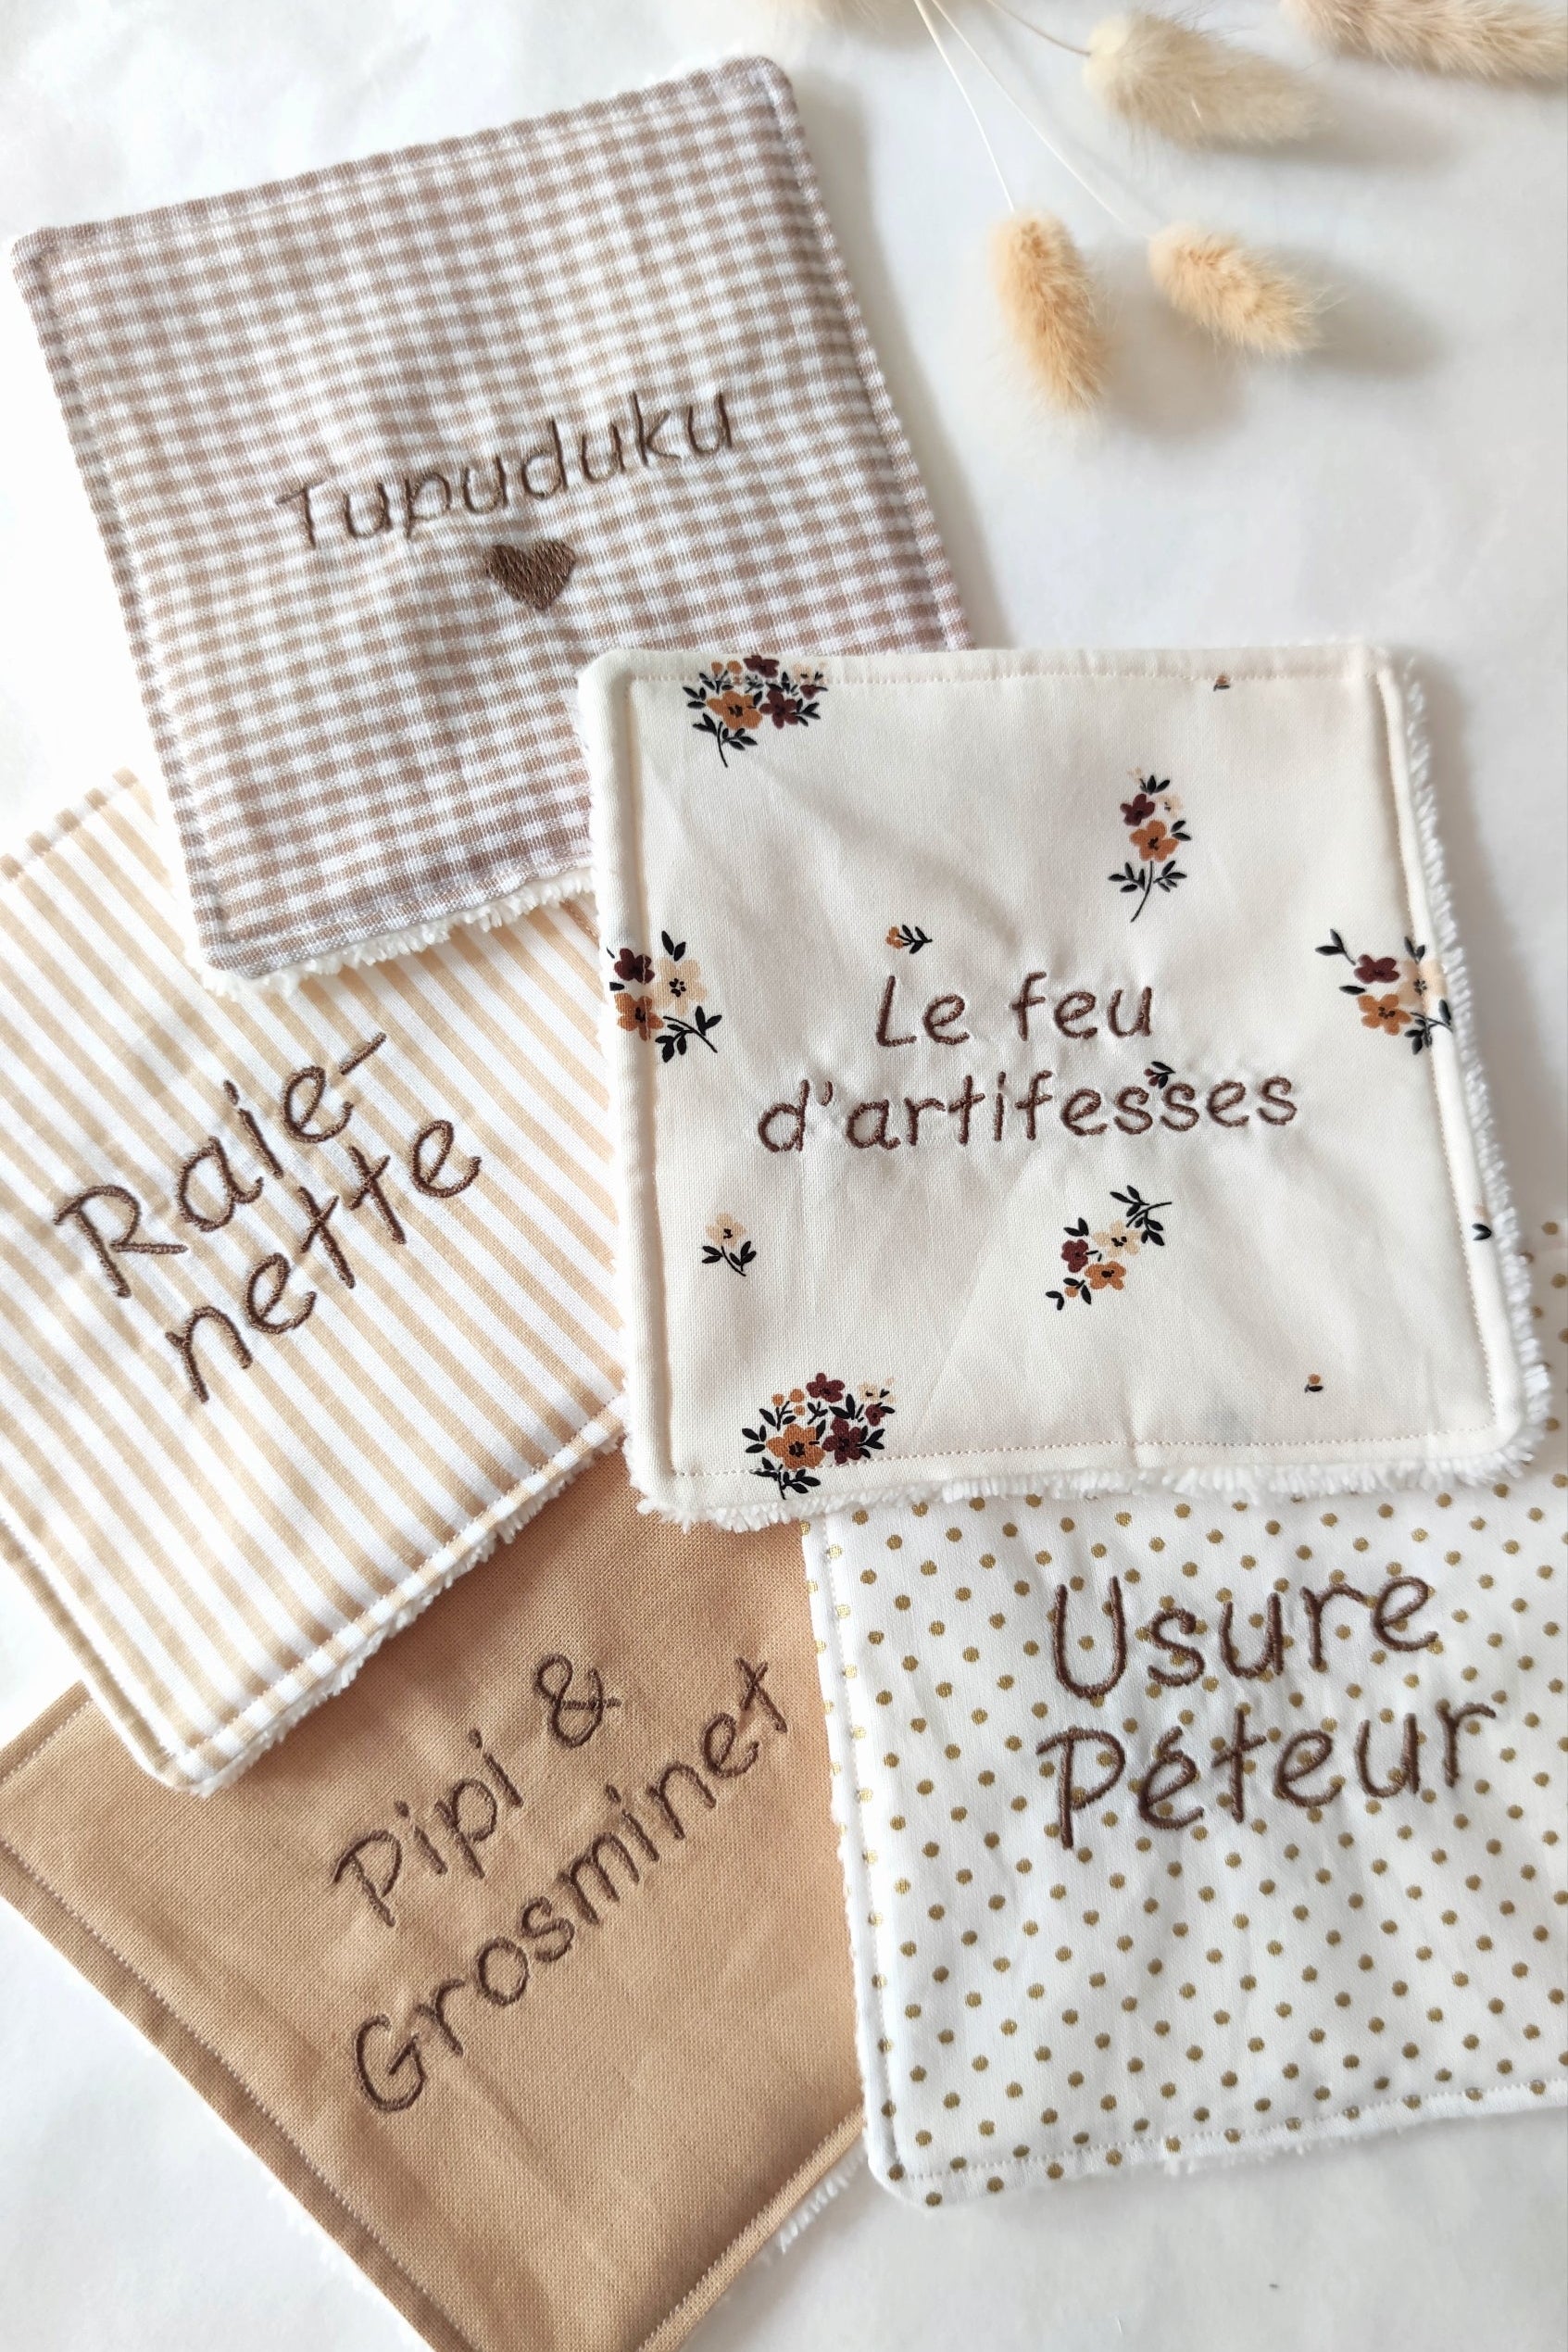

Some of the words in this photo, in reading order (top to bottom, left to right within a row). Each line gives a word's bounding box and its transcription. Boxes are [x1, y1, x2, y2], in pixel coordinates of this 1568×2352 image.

[277, 390, 735, 549] Tupuduku
[875, 975, 972, 1048] Le
[1011, 971, 1155, 1042] feu
[53, 1031, 388, 1298] Raie-
[757, 1069, 1298, 1153] d'artifesses
[164, 1119, 483, 1403] nette
[1051, 1576, 1440, 1700] Usure
[331, 1728, 525, 1928] Pipi
[531, 1653, 622, 1749] &
[1034, 1697, 1498, 1850] Péteur
[352, 1655, 788, 2113] Grosminet
